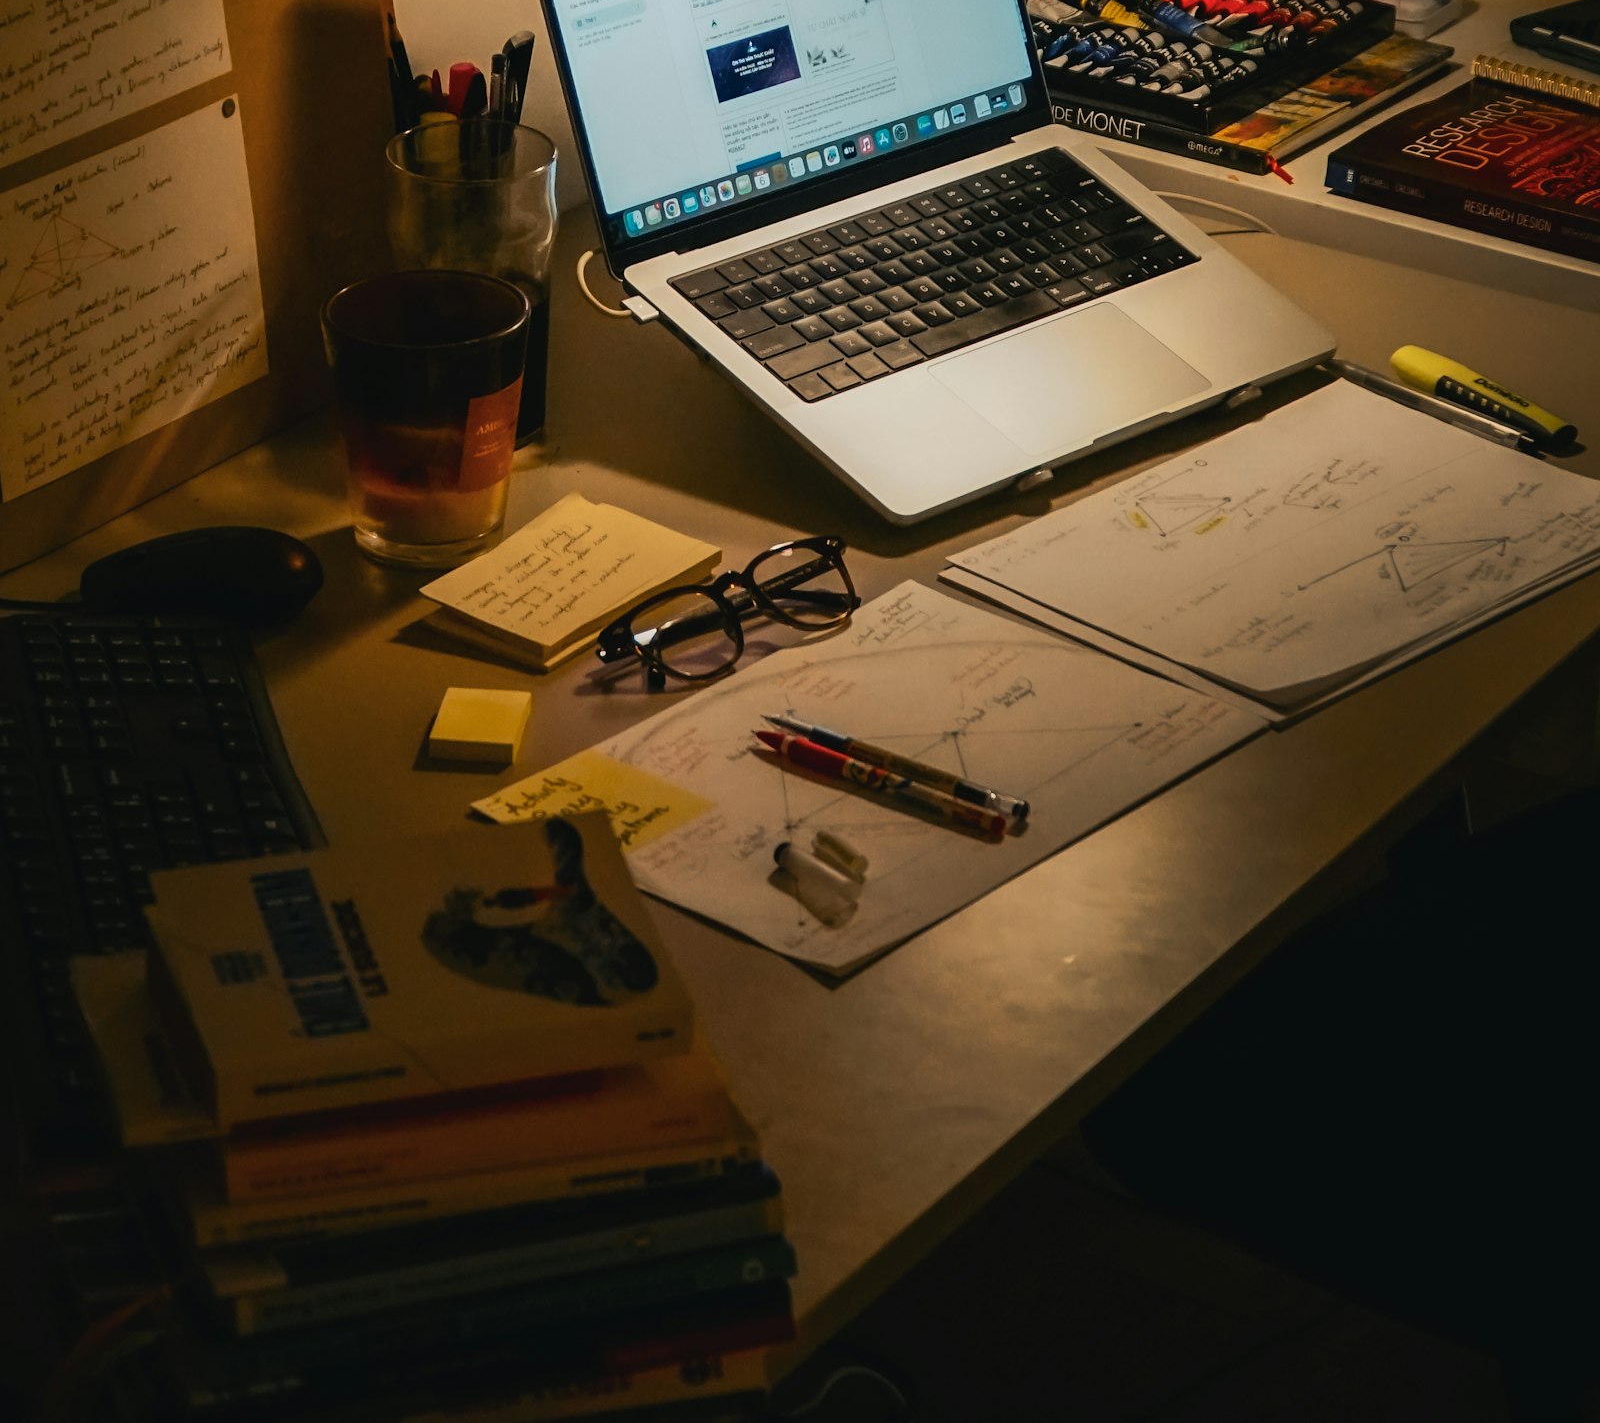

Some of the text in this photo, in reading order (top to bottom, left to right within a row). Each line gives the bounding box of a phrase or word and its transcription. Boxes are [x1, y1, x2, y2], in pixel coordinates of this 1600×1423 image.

[1076, 107, 1147, 140] MONET
[1401, 94, 1533, 159] RESEARCH
[1435, 105, 1581, 172] DESIGN
[759, 177, 766, 185] 6
[1463, 198, 1553, 234] RESEARCH DESIGN
